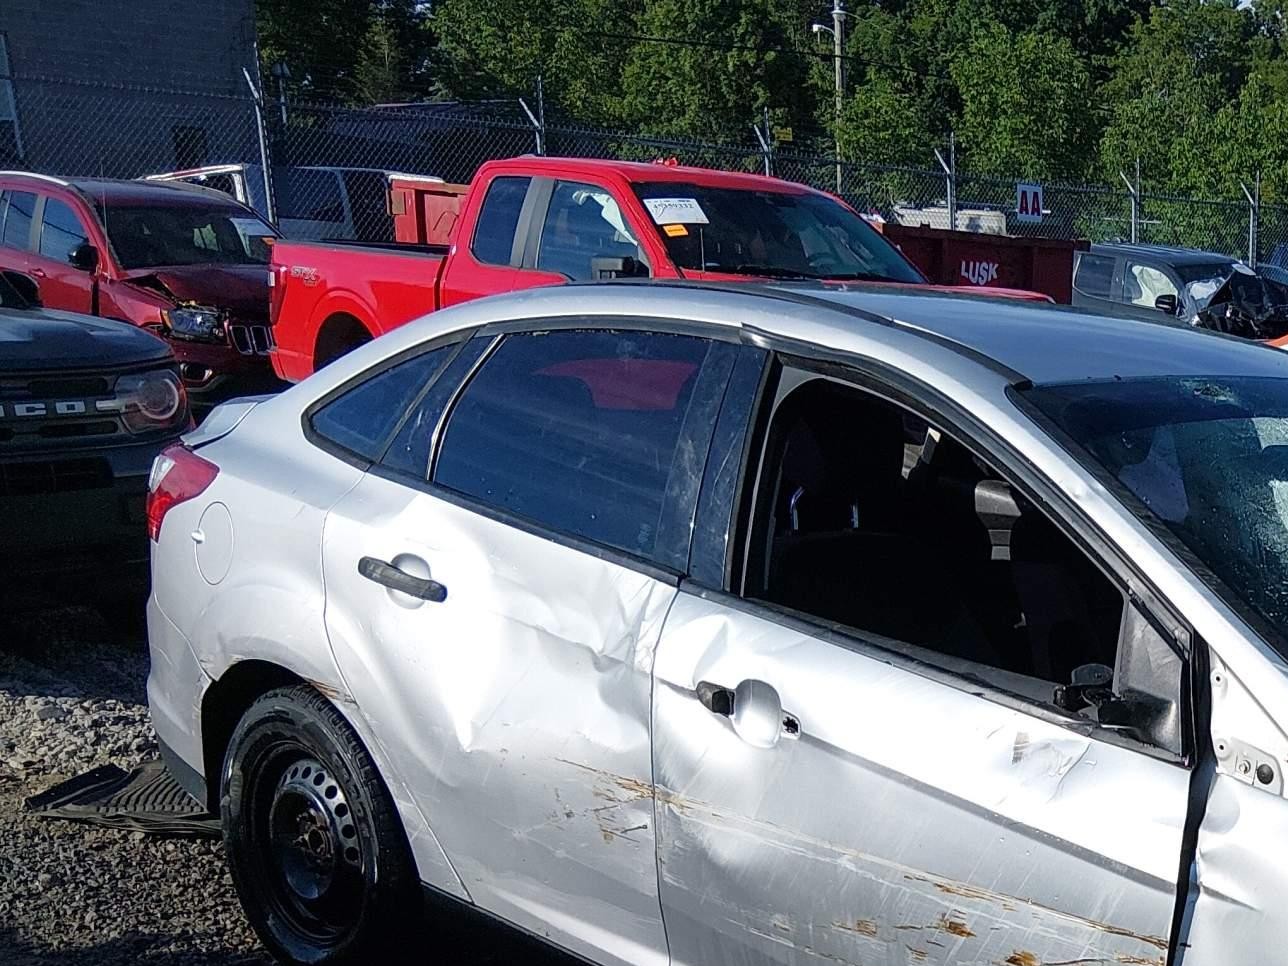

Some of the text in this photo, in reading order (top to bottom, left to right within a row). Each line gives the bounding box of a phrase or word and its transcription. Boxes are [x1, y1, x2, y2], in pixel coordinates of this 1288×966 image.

[1018, 190, 1041, 217] AA
[961, 260, 999, 286] LUSK
[0, 401, 86, 417] CO
